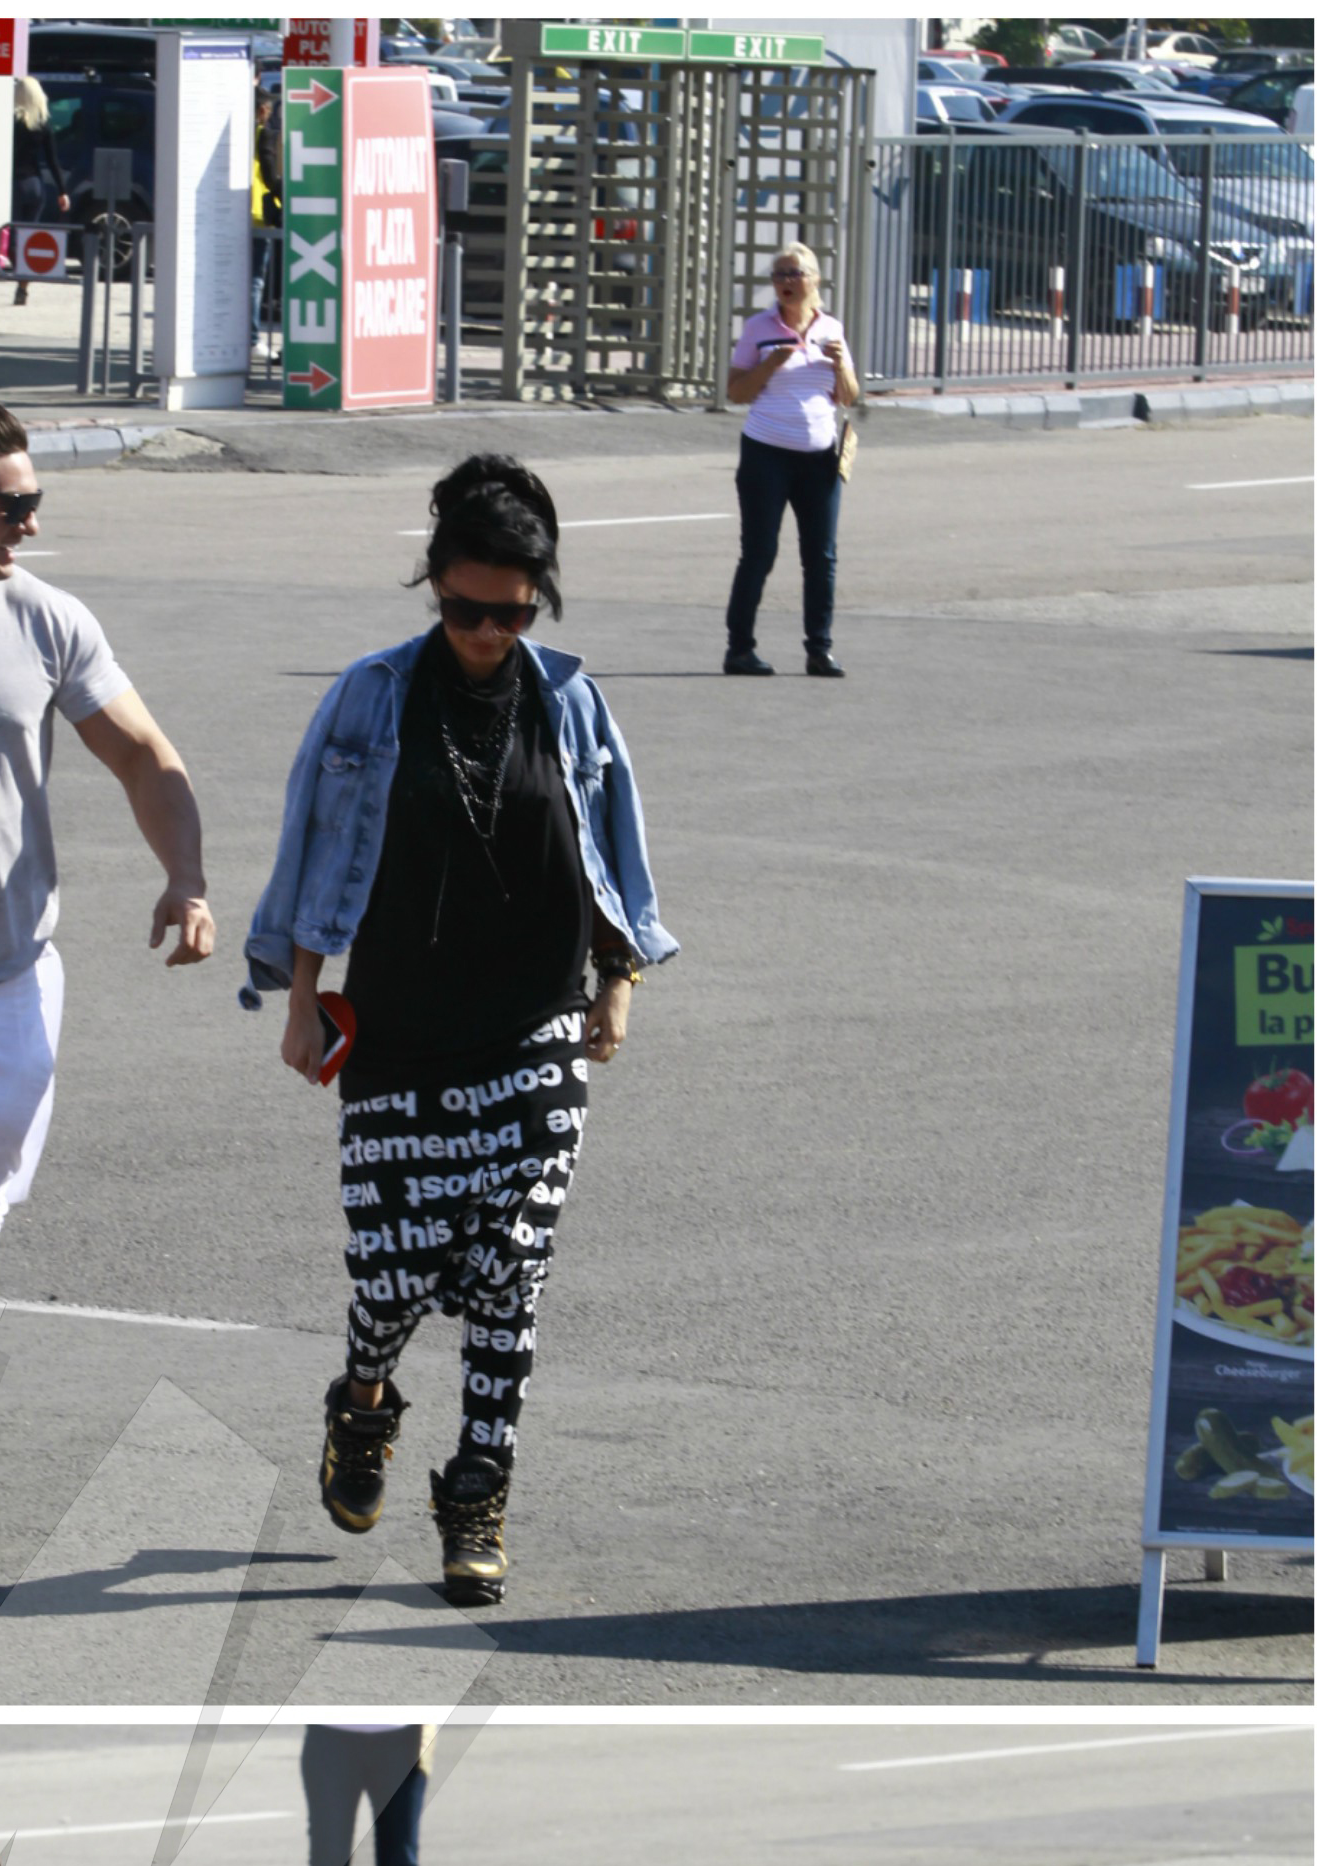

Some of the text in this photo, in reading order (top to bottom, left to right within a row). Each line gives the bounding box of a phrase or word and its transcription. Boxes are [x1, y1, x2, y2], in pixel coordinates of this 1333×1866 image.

[288, 20, 367, 36] AUTOT
[588, 29, 643, 54] EXIT
[734, 36, 787, 59] EXIT
[353, 136, 428, 196] AUTOMAT
[288, 130, 338, 345] EXIT
[365, 207, 416, 267] PLATA
[354, 277, 426, 339] PARCARE
[1259, 1008, 1286, 1036] la
[346, 1223, 397, 1261] ept
